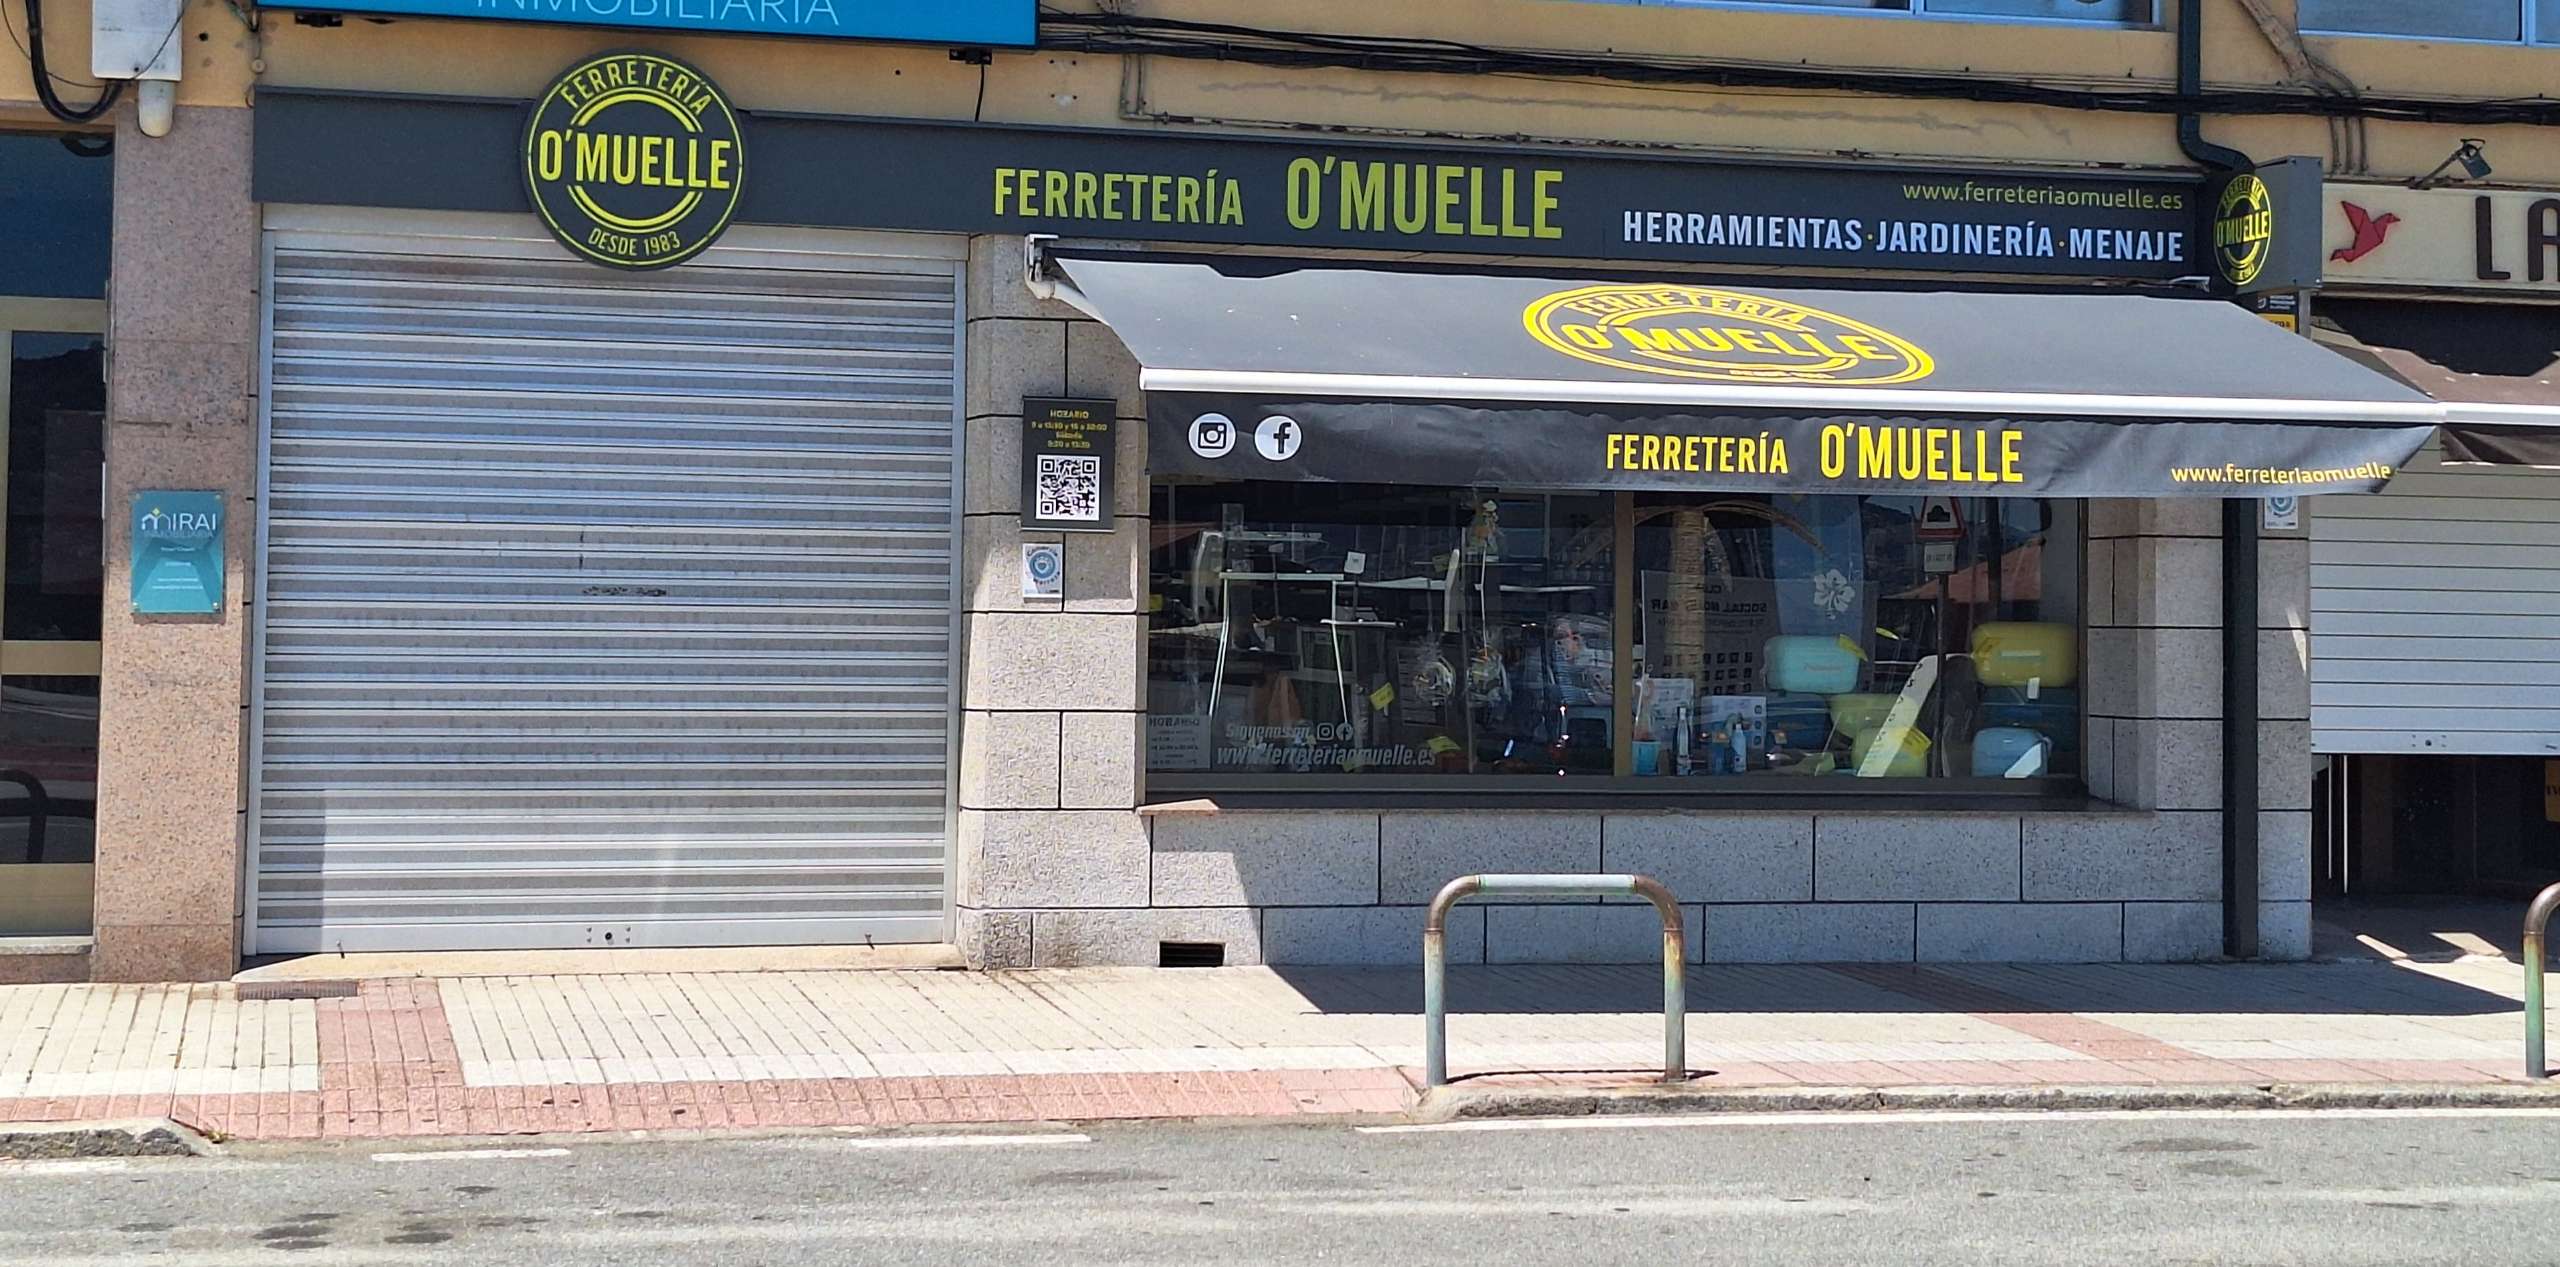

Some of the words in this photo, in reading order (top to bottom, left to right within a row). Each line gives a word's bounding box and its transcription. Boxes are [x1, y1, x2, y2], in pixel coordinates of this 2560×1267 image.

[476, 0, 840, 26] LIARIA
[994, 166, 1245, 226] FERRETERÍA
[1902, 181, 2183, 211] www.ferreteriaomuelle.es
[588, 227, 638, 256] DESDE
[644, 230, 681, 256] 1983
[1622, 210, 1862, 250] HERRAMIENTAS
[2068, 226, 2184, 262] MENAJE
[1606, 431, 1788, 474] FERRETERÍA
